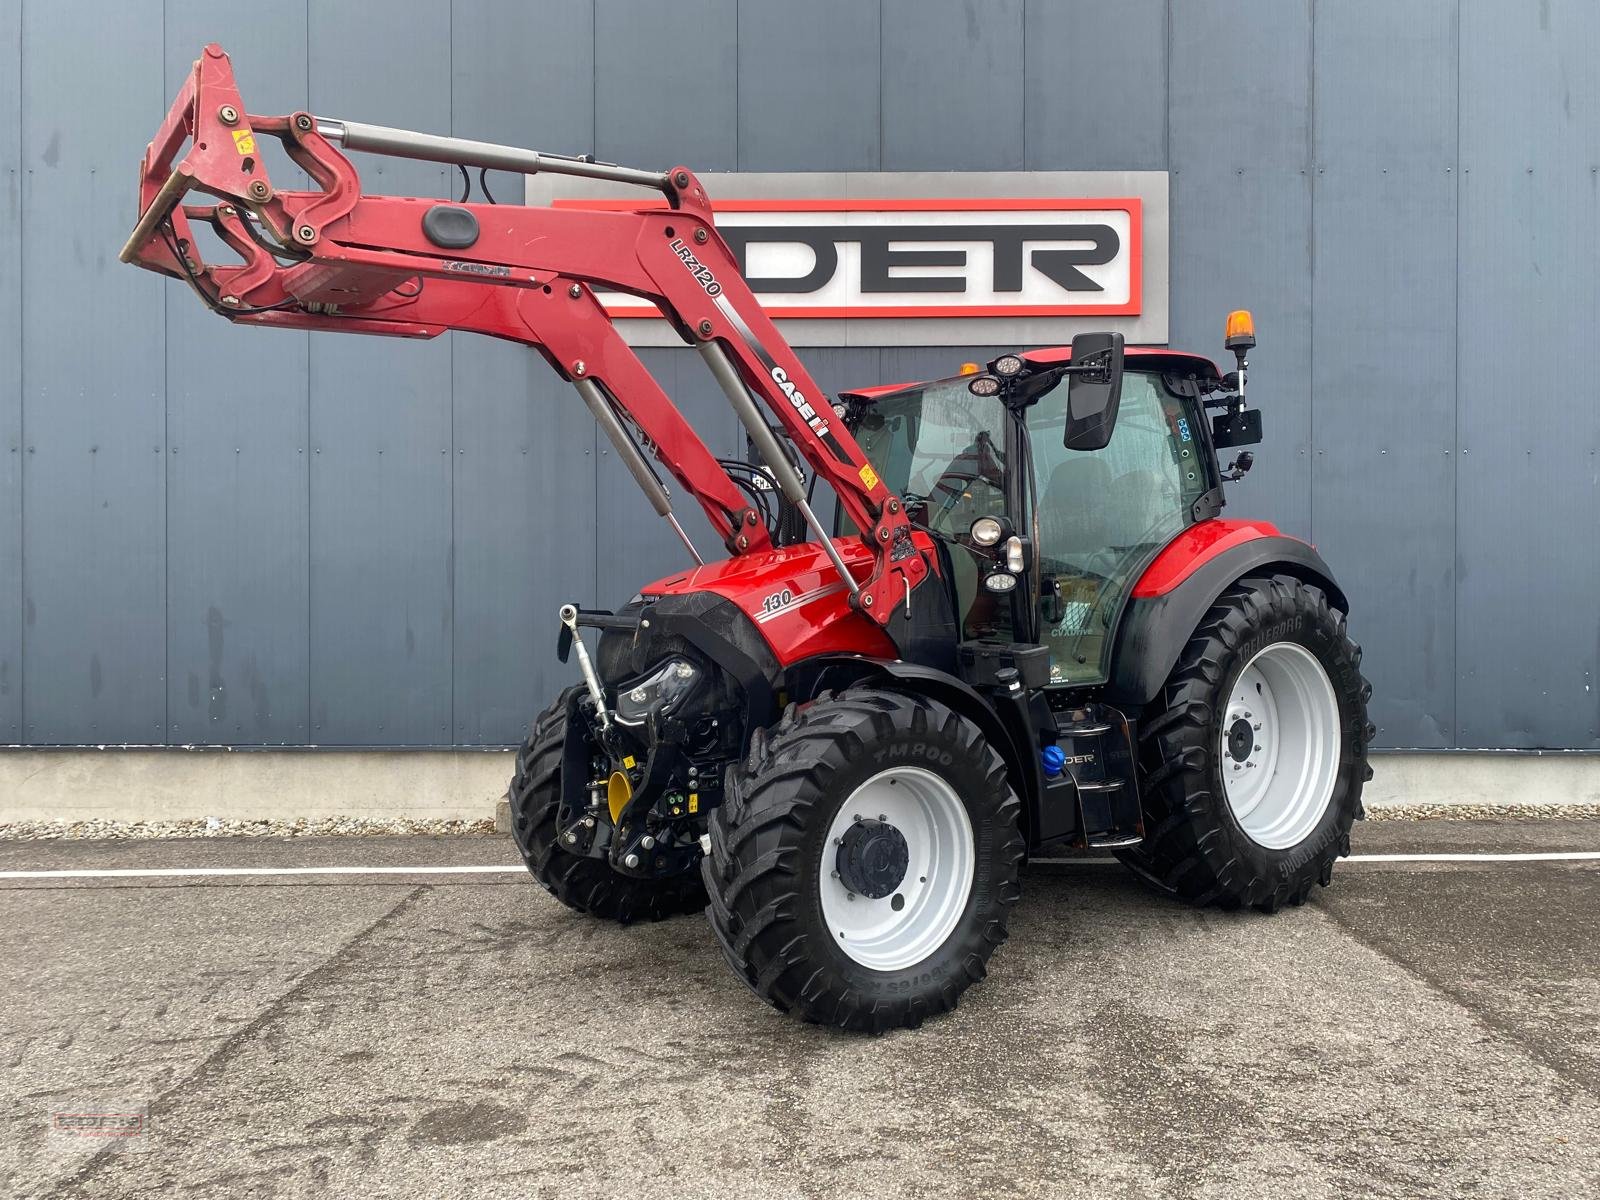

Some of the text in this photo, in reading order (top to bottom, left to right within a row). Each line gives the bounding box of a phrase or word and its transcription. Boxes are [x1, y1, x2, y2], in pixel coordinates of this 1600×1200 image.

[669, 238, 722, 297] LRZ120
[715, 224, 1121, 293] DER
[771, 366, 816, 420] CASE
[763, 589, 792, 613] 130
[1063, 754, 1095, 765] DER
